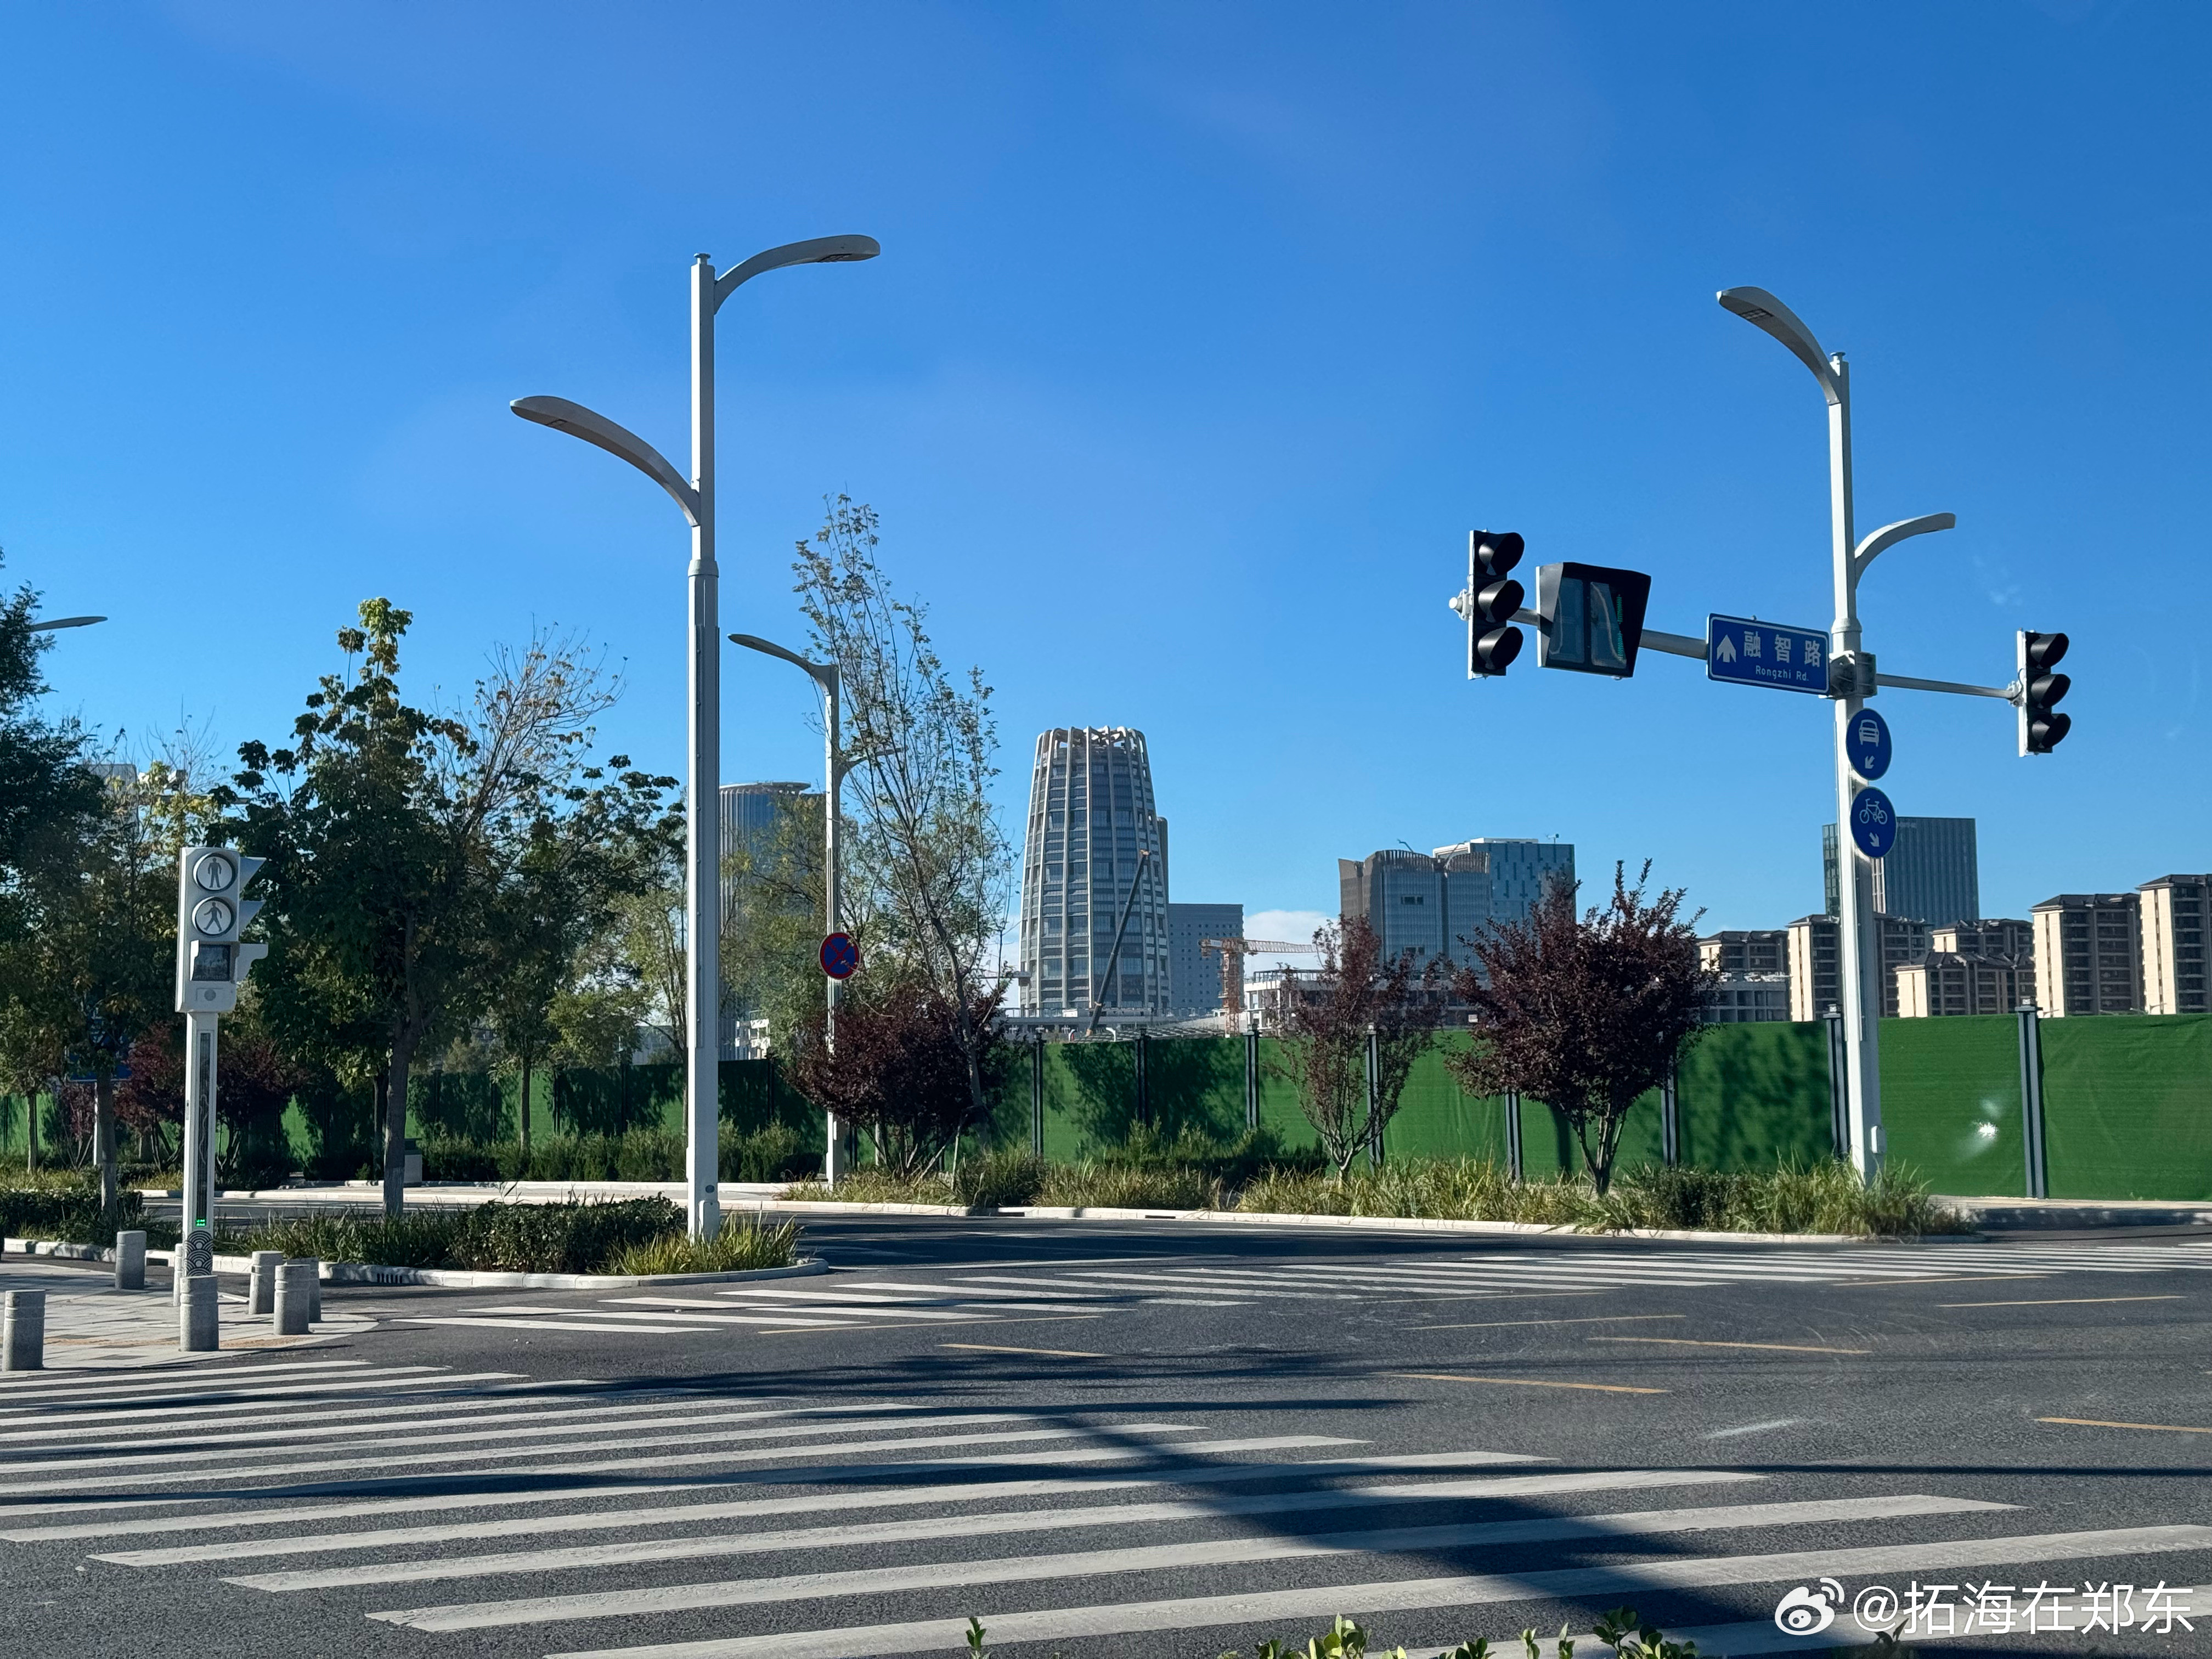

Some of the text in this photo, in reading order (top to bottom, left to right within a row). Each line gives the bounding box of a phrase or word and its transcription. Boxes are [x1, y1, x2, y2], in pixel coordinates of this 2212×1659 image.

[1743, 630, 1821, 668] 融智路
[1756, 665, 1792, 680] Rongzhi
